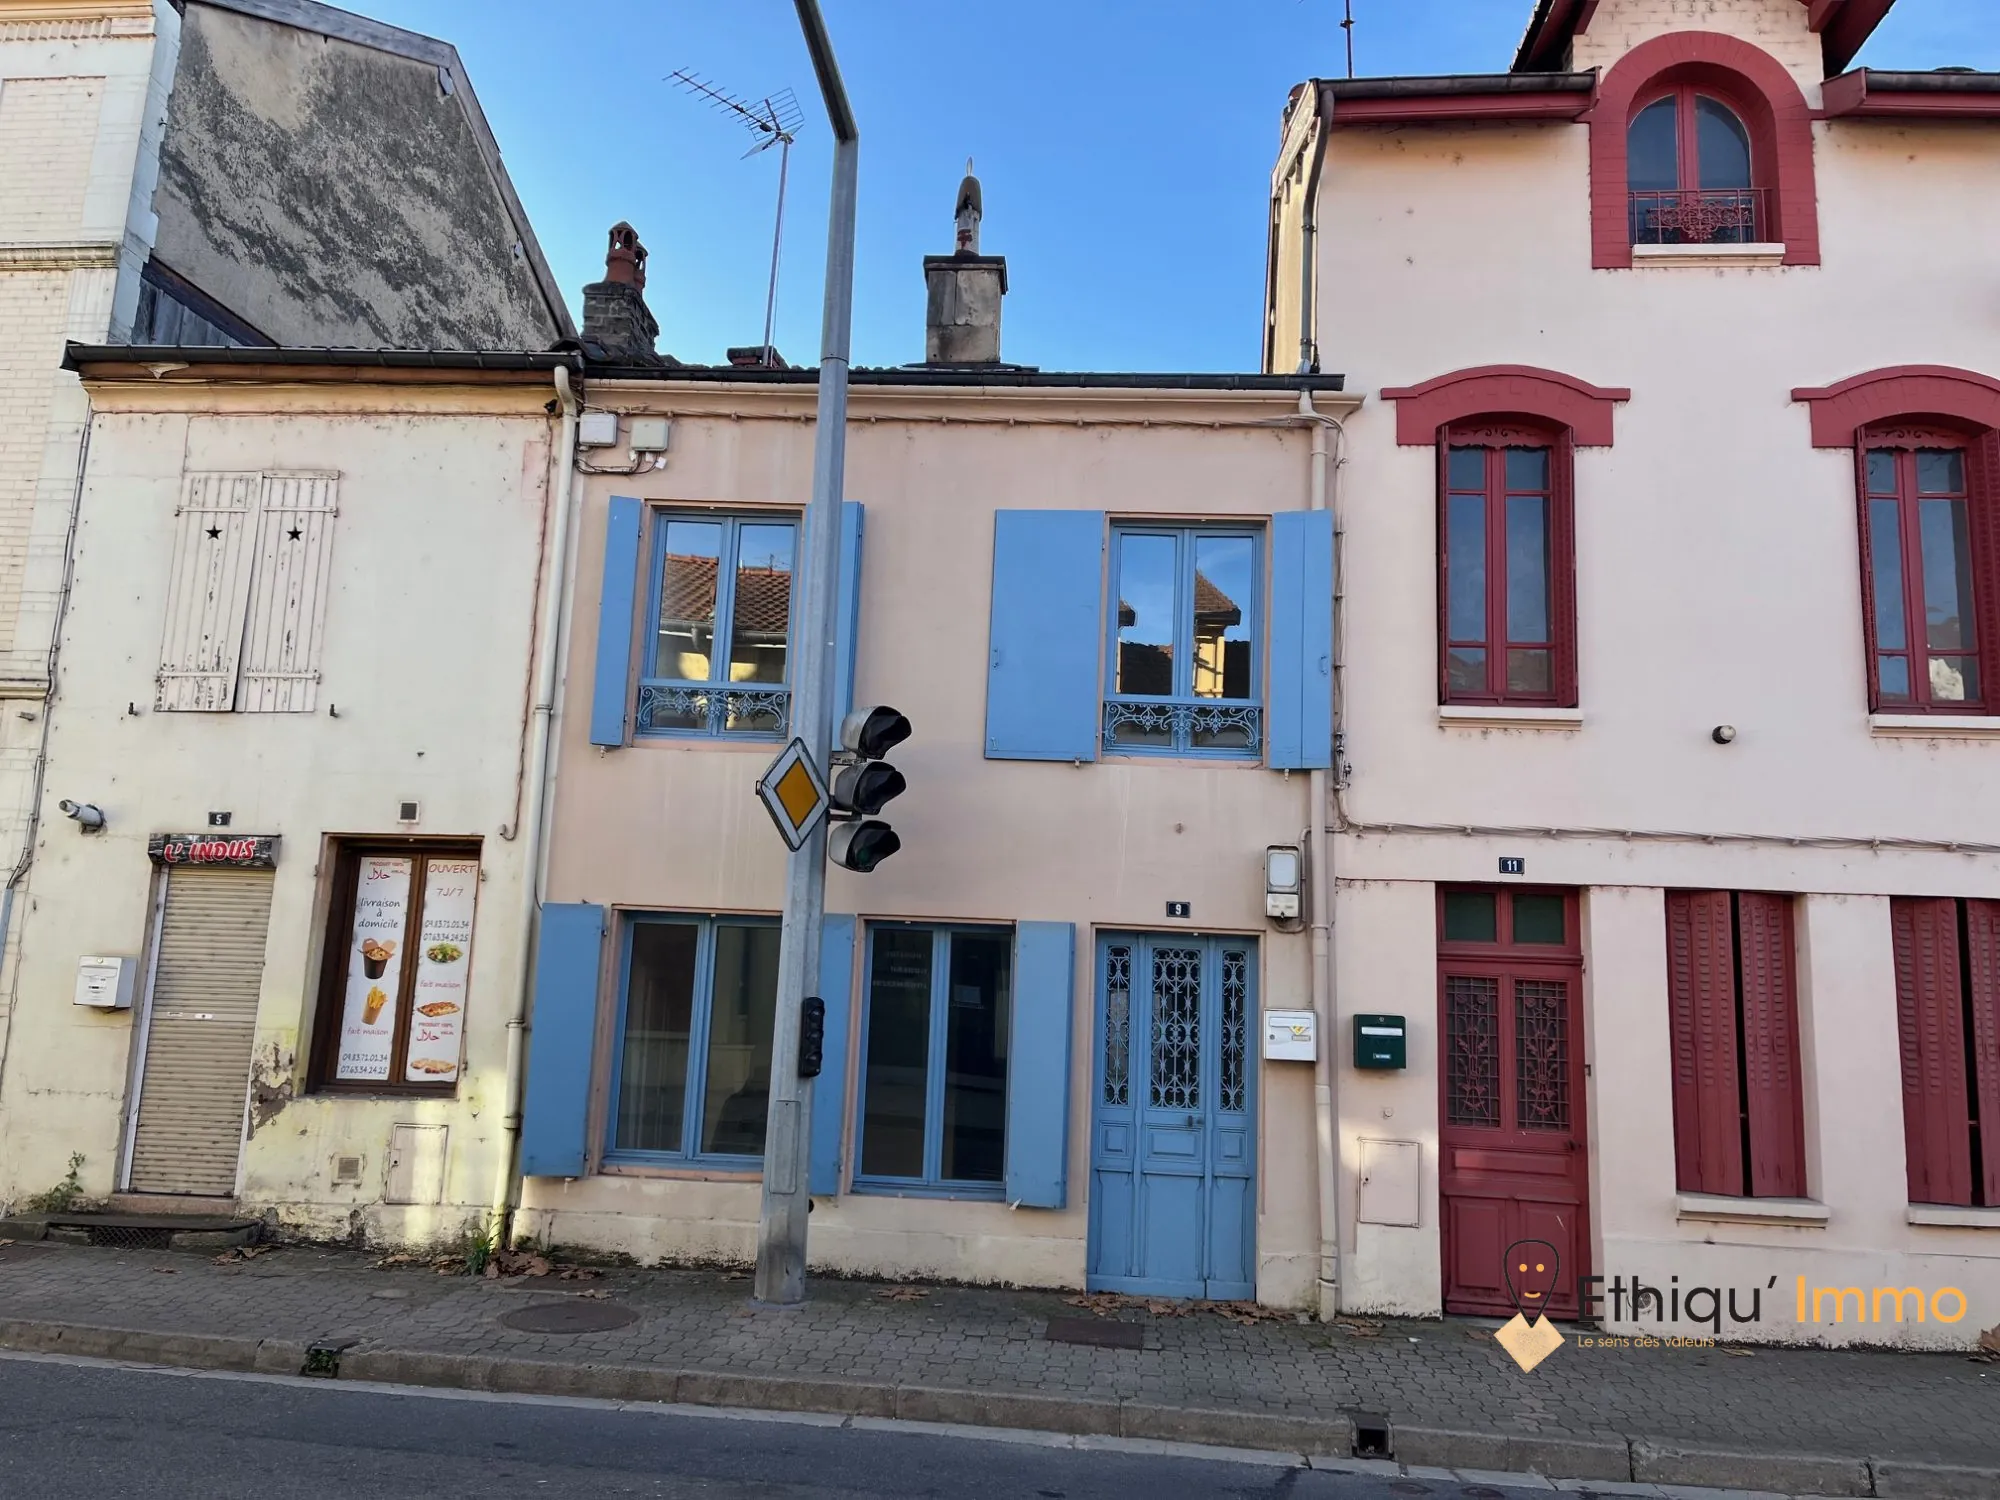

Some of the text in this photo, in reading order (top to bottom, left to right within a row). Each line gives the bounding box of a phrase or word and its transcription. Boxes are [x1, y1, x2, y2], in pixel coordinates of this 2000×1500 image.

[215, 814, 222, 825] 5
[164, 838, 257, 862] L' INDUS
[429, 863, 477, 874] OUVERT
[1507, 860, 1518, 871] 11
[361, 897, 401, 908] livraison
[376, 907, 382, 917] à
[1175, 904, 1182, 915] 9
[358, 918, 399, 929] domicile
